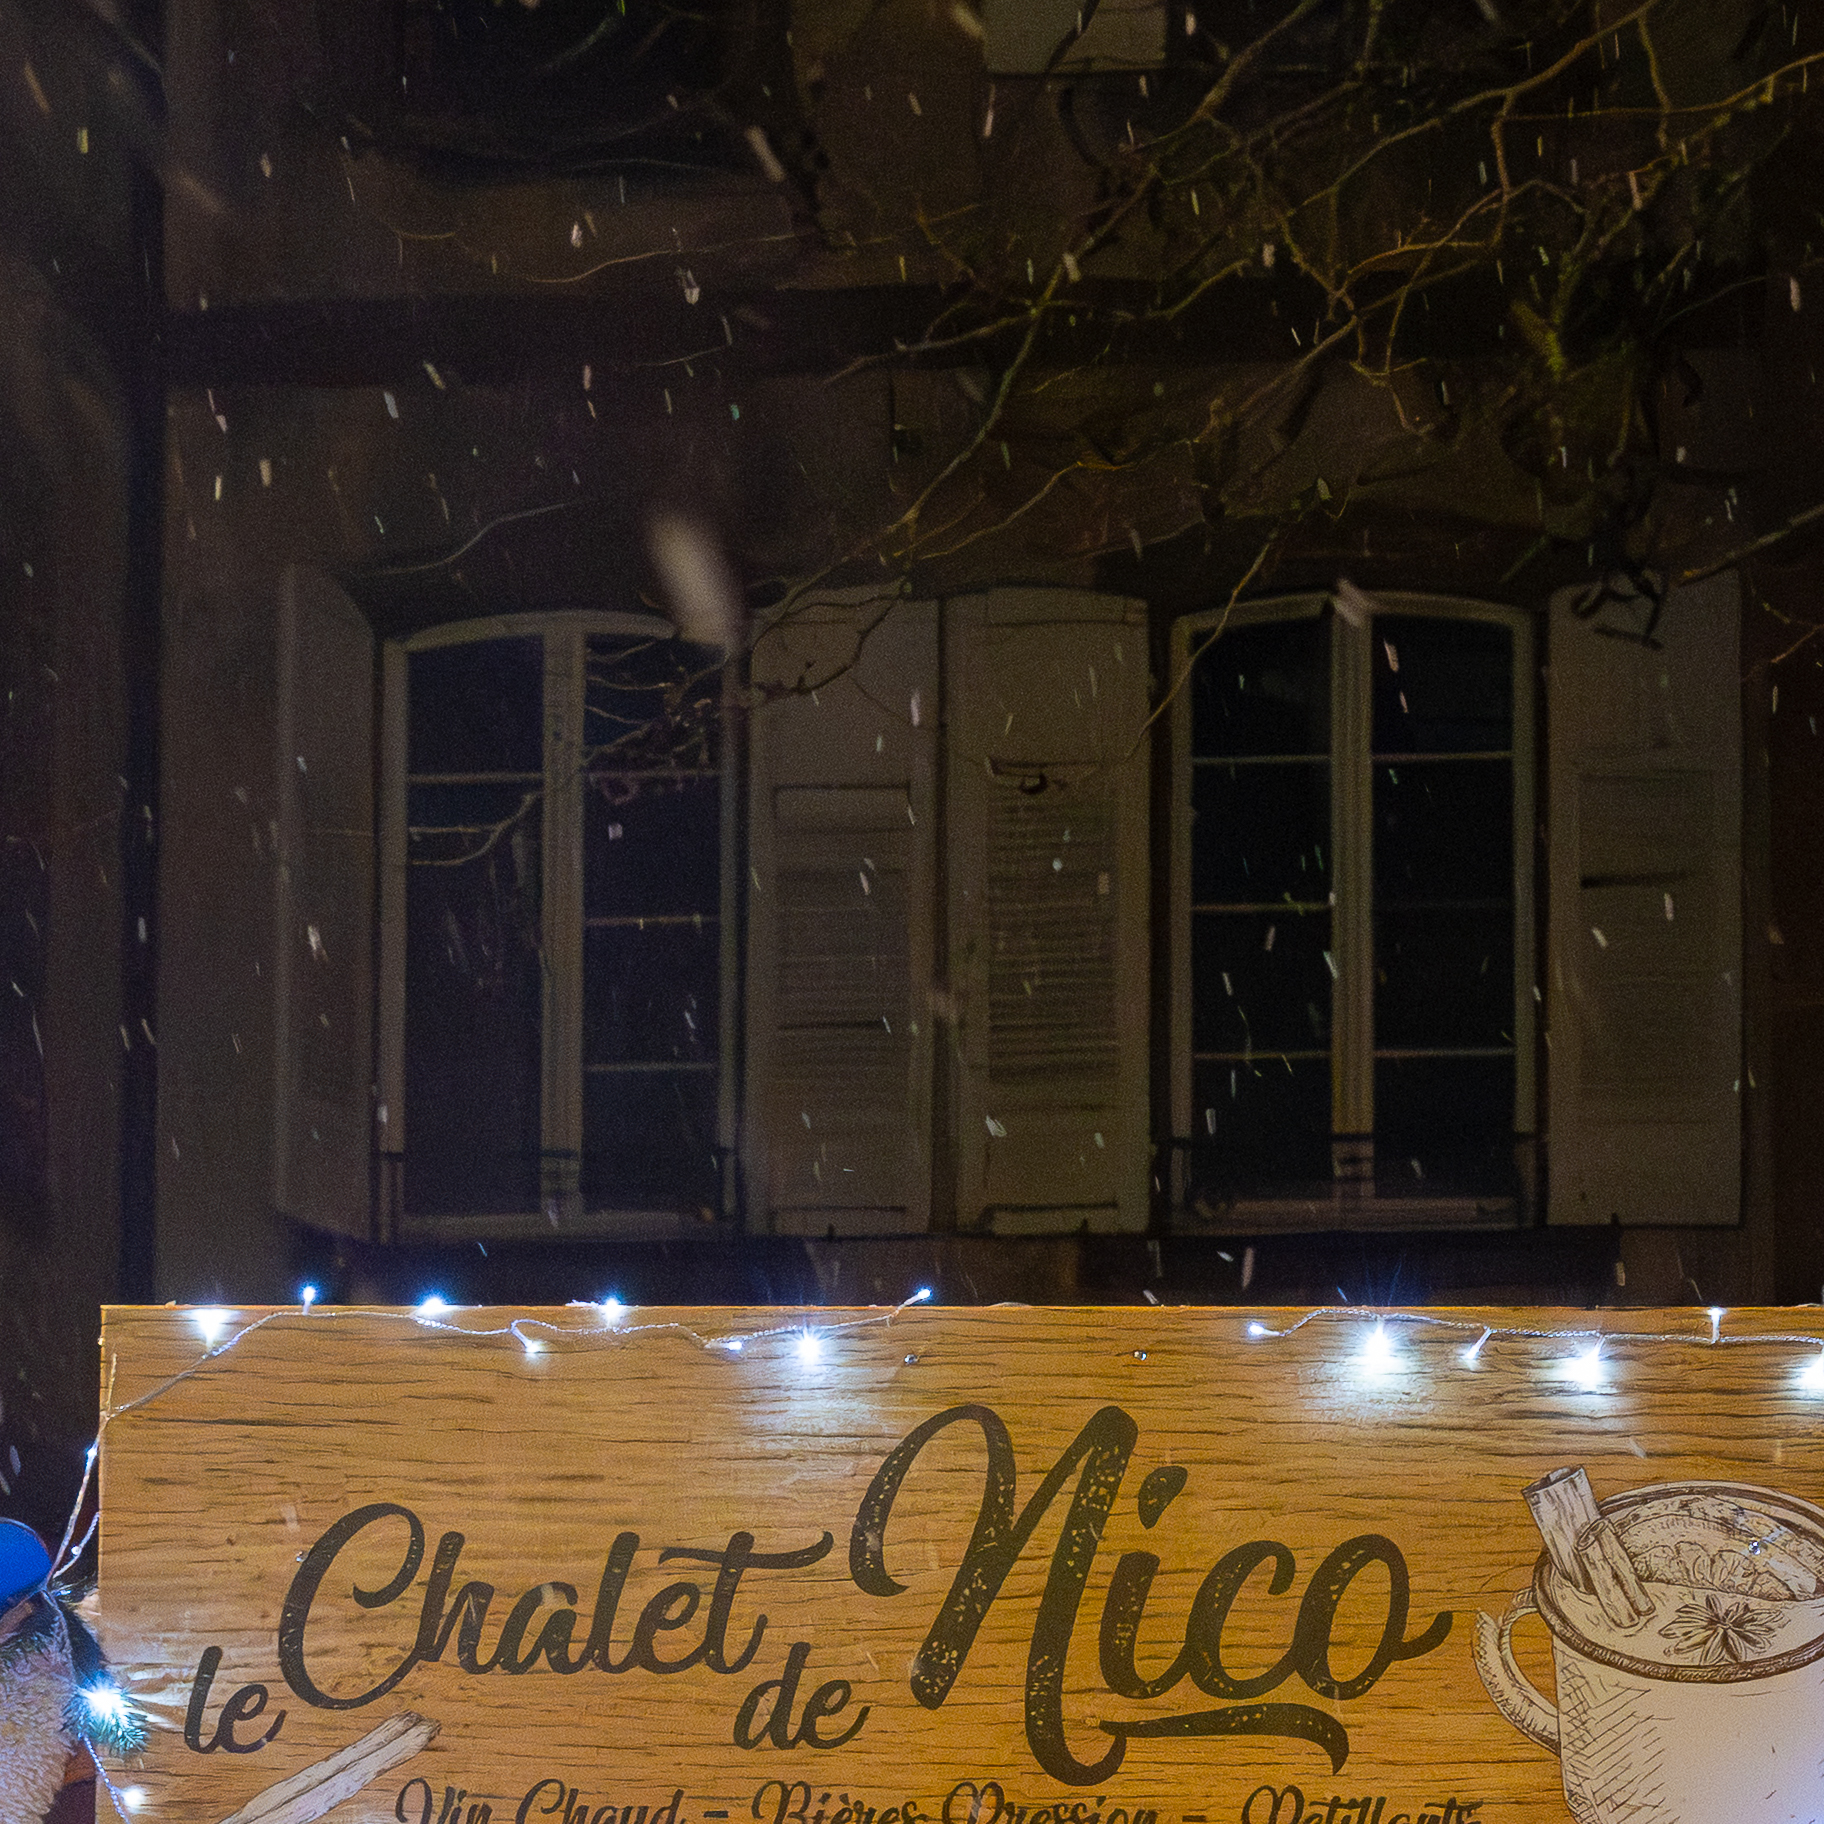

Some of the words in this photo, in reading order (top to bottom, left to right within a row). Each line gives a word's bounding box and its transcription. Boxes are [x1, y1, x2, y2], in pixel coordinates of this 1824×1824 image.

[184, 1645, 283, 1757] le
[277, 1502, 835, 1712] Chalet
[736, 1637, 868, 1752] de
[851, 1404, 1453, 1786] Nico
